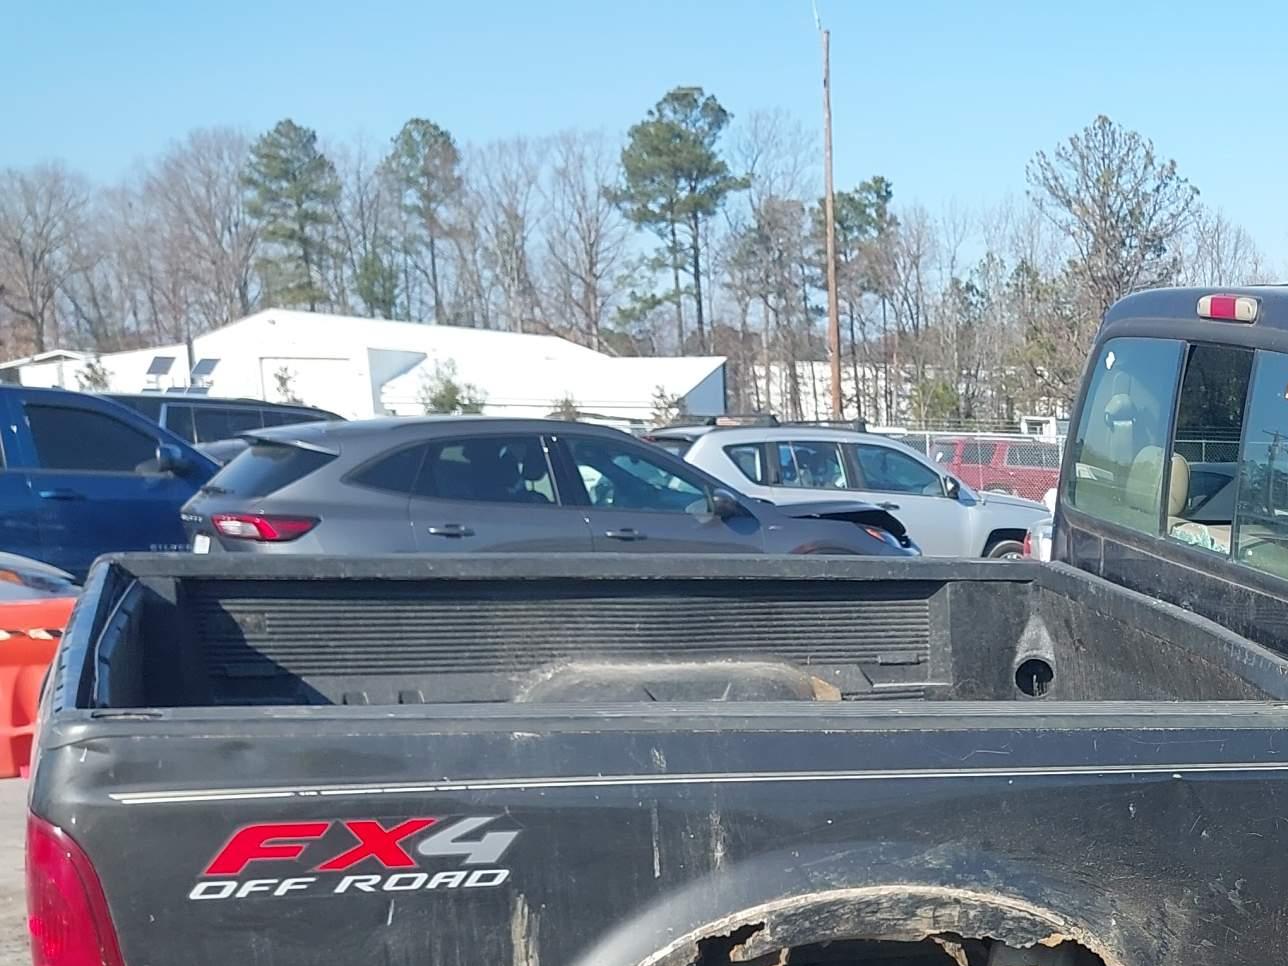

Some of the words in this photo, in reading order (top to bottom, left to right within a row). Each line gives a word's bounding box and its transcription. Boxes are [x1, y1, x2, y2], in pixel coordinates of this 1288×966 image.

[203, 816, 520, 876] FX4
[189, 877, 318, 900] OFF
[333, 869, 510, 893] ROAD
